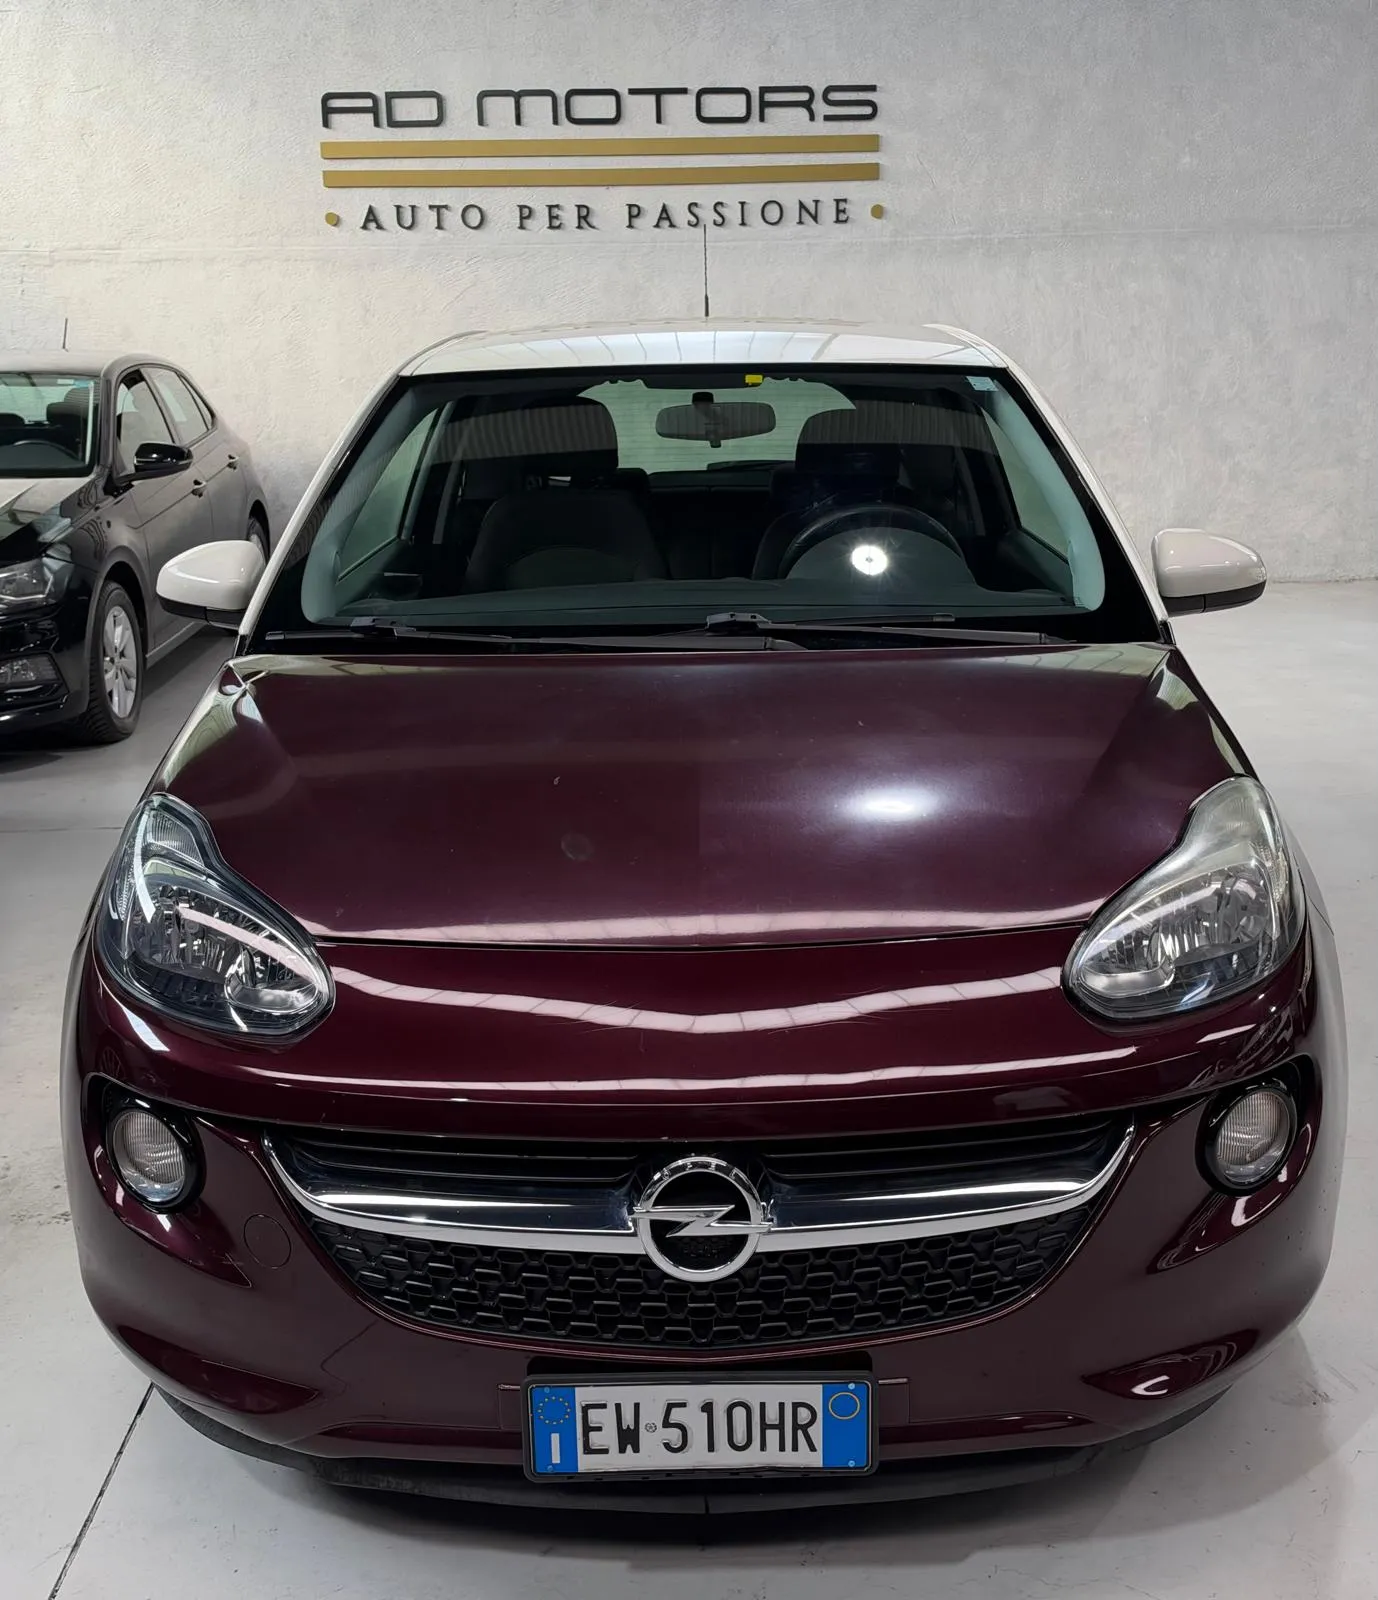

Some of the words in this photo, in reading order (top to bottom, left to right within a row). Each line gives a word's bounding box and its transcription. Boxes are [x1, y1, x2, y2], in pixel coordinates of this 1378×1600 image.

[320, 91, 444, 129] AD
[476, 84, 879, 127] MOTORS
[360, 204, 487, 231] AUTO
[516, 203, 597, 231] PER
[625, 198, 850, 229] PASSIONE
